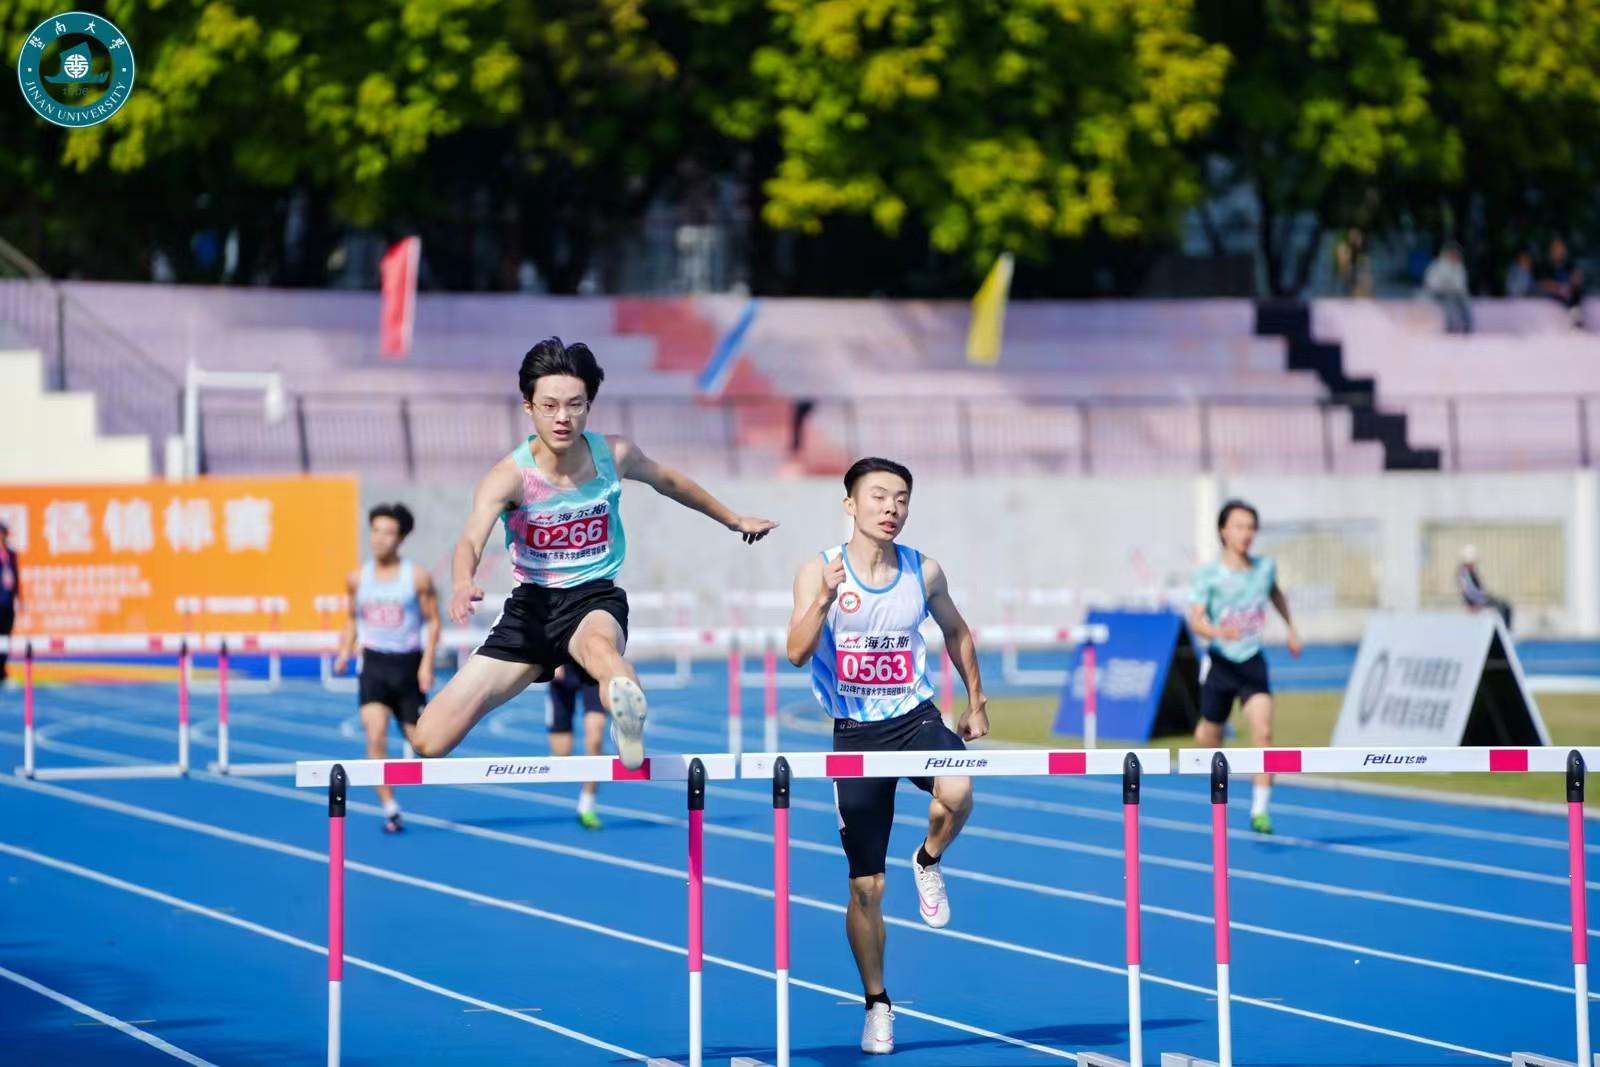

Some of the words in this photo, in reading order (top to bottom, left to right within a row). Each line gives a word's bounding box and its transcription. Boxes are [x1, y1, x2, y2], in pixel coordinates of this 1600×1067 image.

[557, 502, 607, 523] 海尔斯
[533, 519, 604, 547] 0266
[864, 636, 910, 649] 海尔斯
[842, 654, 908, 682] 0563
